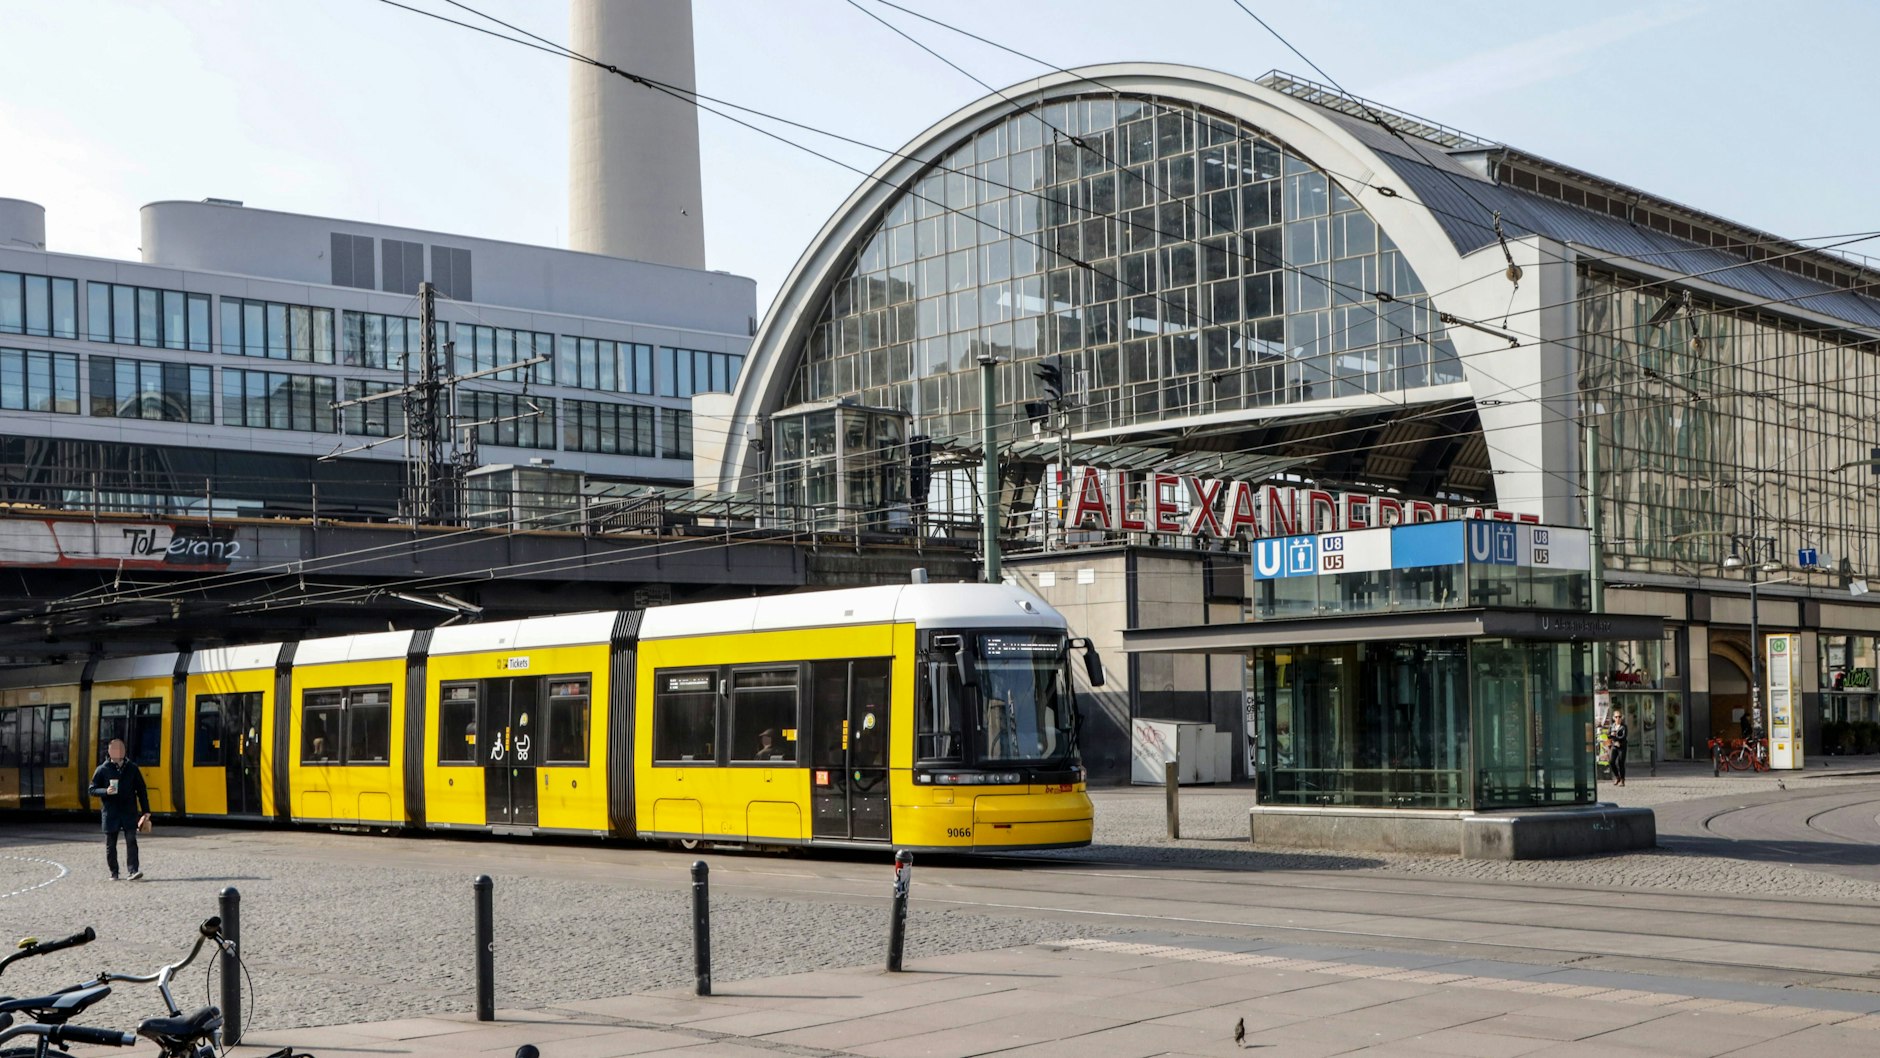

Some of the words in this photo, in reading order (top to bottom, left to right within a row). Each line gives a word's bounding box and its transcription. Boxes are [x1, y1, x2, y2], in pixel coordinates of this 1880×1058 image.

[1471, 523, 1489, 561] U
[1534, 531, 1548, 543] U8
[1325, 538, 1342, 551] U8
[1258, 541, 1280, 577] U
[1325, 556, 1343, 569] U5
[1534, 550, 1548, 562] U5
[1542, 616, 1549, 630] U
[509, 658, 528, 669] Tickets
[947, 827, 971, 838] 9066
